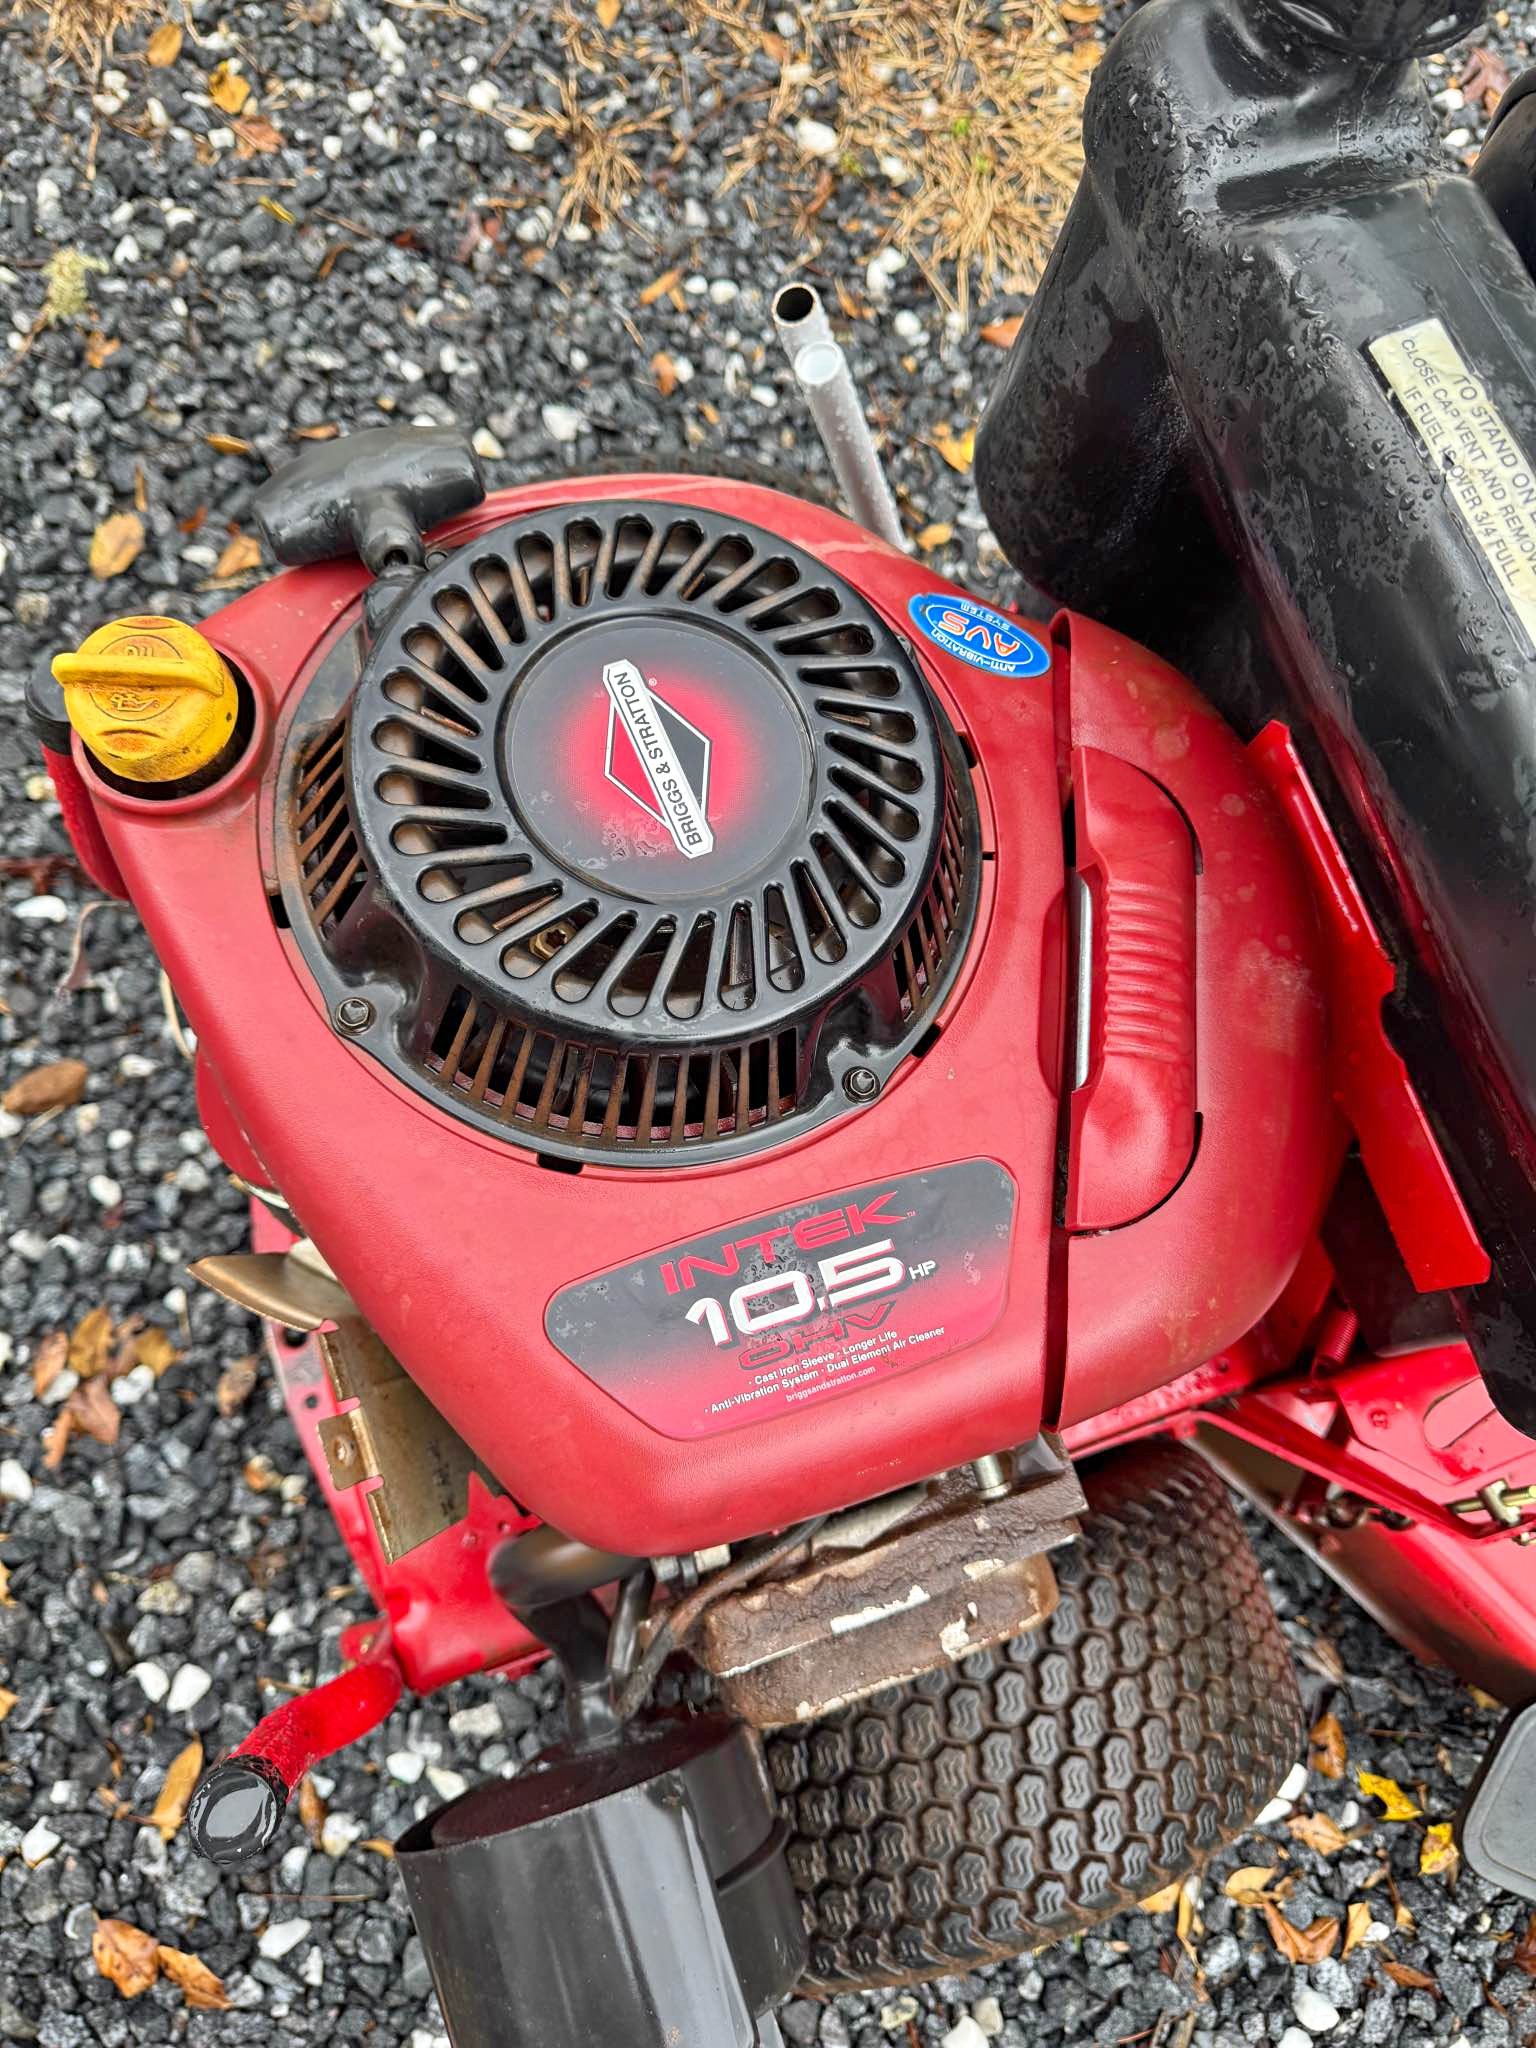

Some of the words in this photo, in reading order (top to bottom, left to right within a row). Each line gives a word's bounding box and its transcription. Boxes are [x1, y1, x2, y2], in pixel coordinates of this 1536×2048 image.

[1401, 339, 1440, 387] CLOSE
[1433, 388, 1460, 418] CAP
[1454, 420, 1488, 462] VENT
[1478, 468, 1507, 501] AND
[1499, 503, 1536, 576] REMOV
[1403, 386, 1423, 400] IF
[1414, 402, 1445, 445] FUEL
[1450, 465, 1482, 511] OVER
[1474, 511, 1498, 537] 3/4
[1453, 375, 1478, 401] TO
[1471, 405, 1519, 468] STAND
[930, 628, 1016, 673] ANTI-VIBRATION
[938, 610, 1020, 657] AVS
[960, 601, 1011, 631] SYSTEM
[613, 671, 664, 760] STRATTON
[655, 761, 671, 775] &
[662, 778, 703, 847] BRIGGS
[660, 1190, 906, 1296] INTEK
[684, 1238, 906, 1348] 10.5
[908, 1260, 938, 1281] HP
[710, 1382, 780, 1415] Anti-Vibration
[781, 1368, 820, 1391] System
[826, 1356, 850, 1374] Dual
[851, 1345, 891, 1366] Element
[892, 1338, 908, 1352] Air
[908, 1325, 946, 1346] Cleaner
[753, 1370, 779, 1386] Cast
[779, 1360, 801, 1379] Iron
[801, 1350, 836, 1370] Sleeve
[841, 1337, 878, 1359] Longer
[878, 1328, 899, 1344] Life
